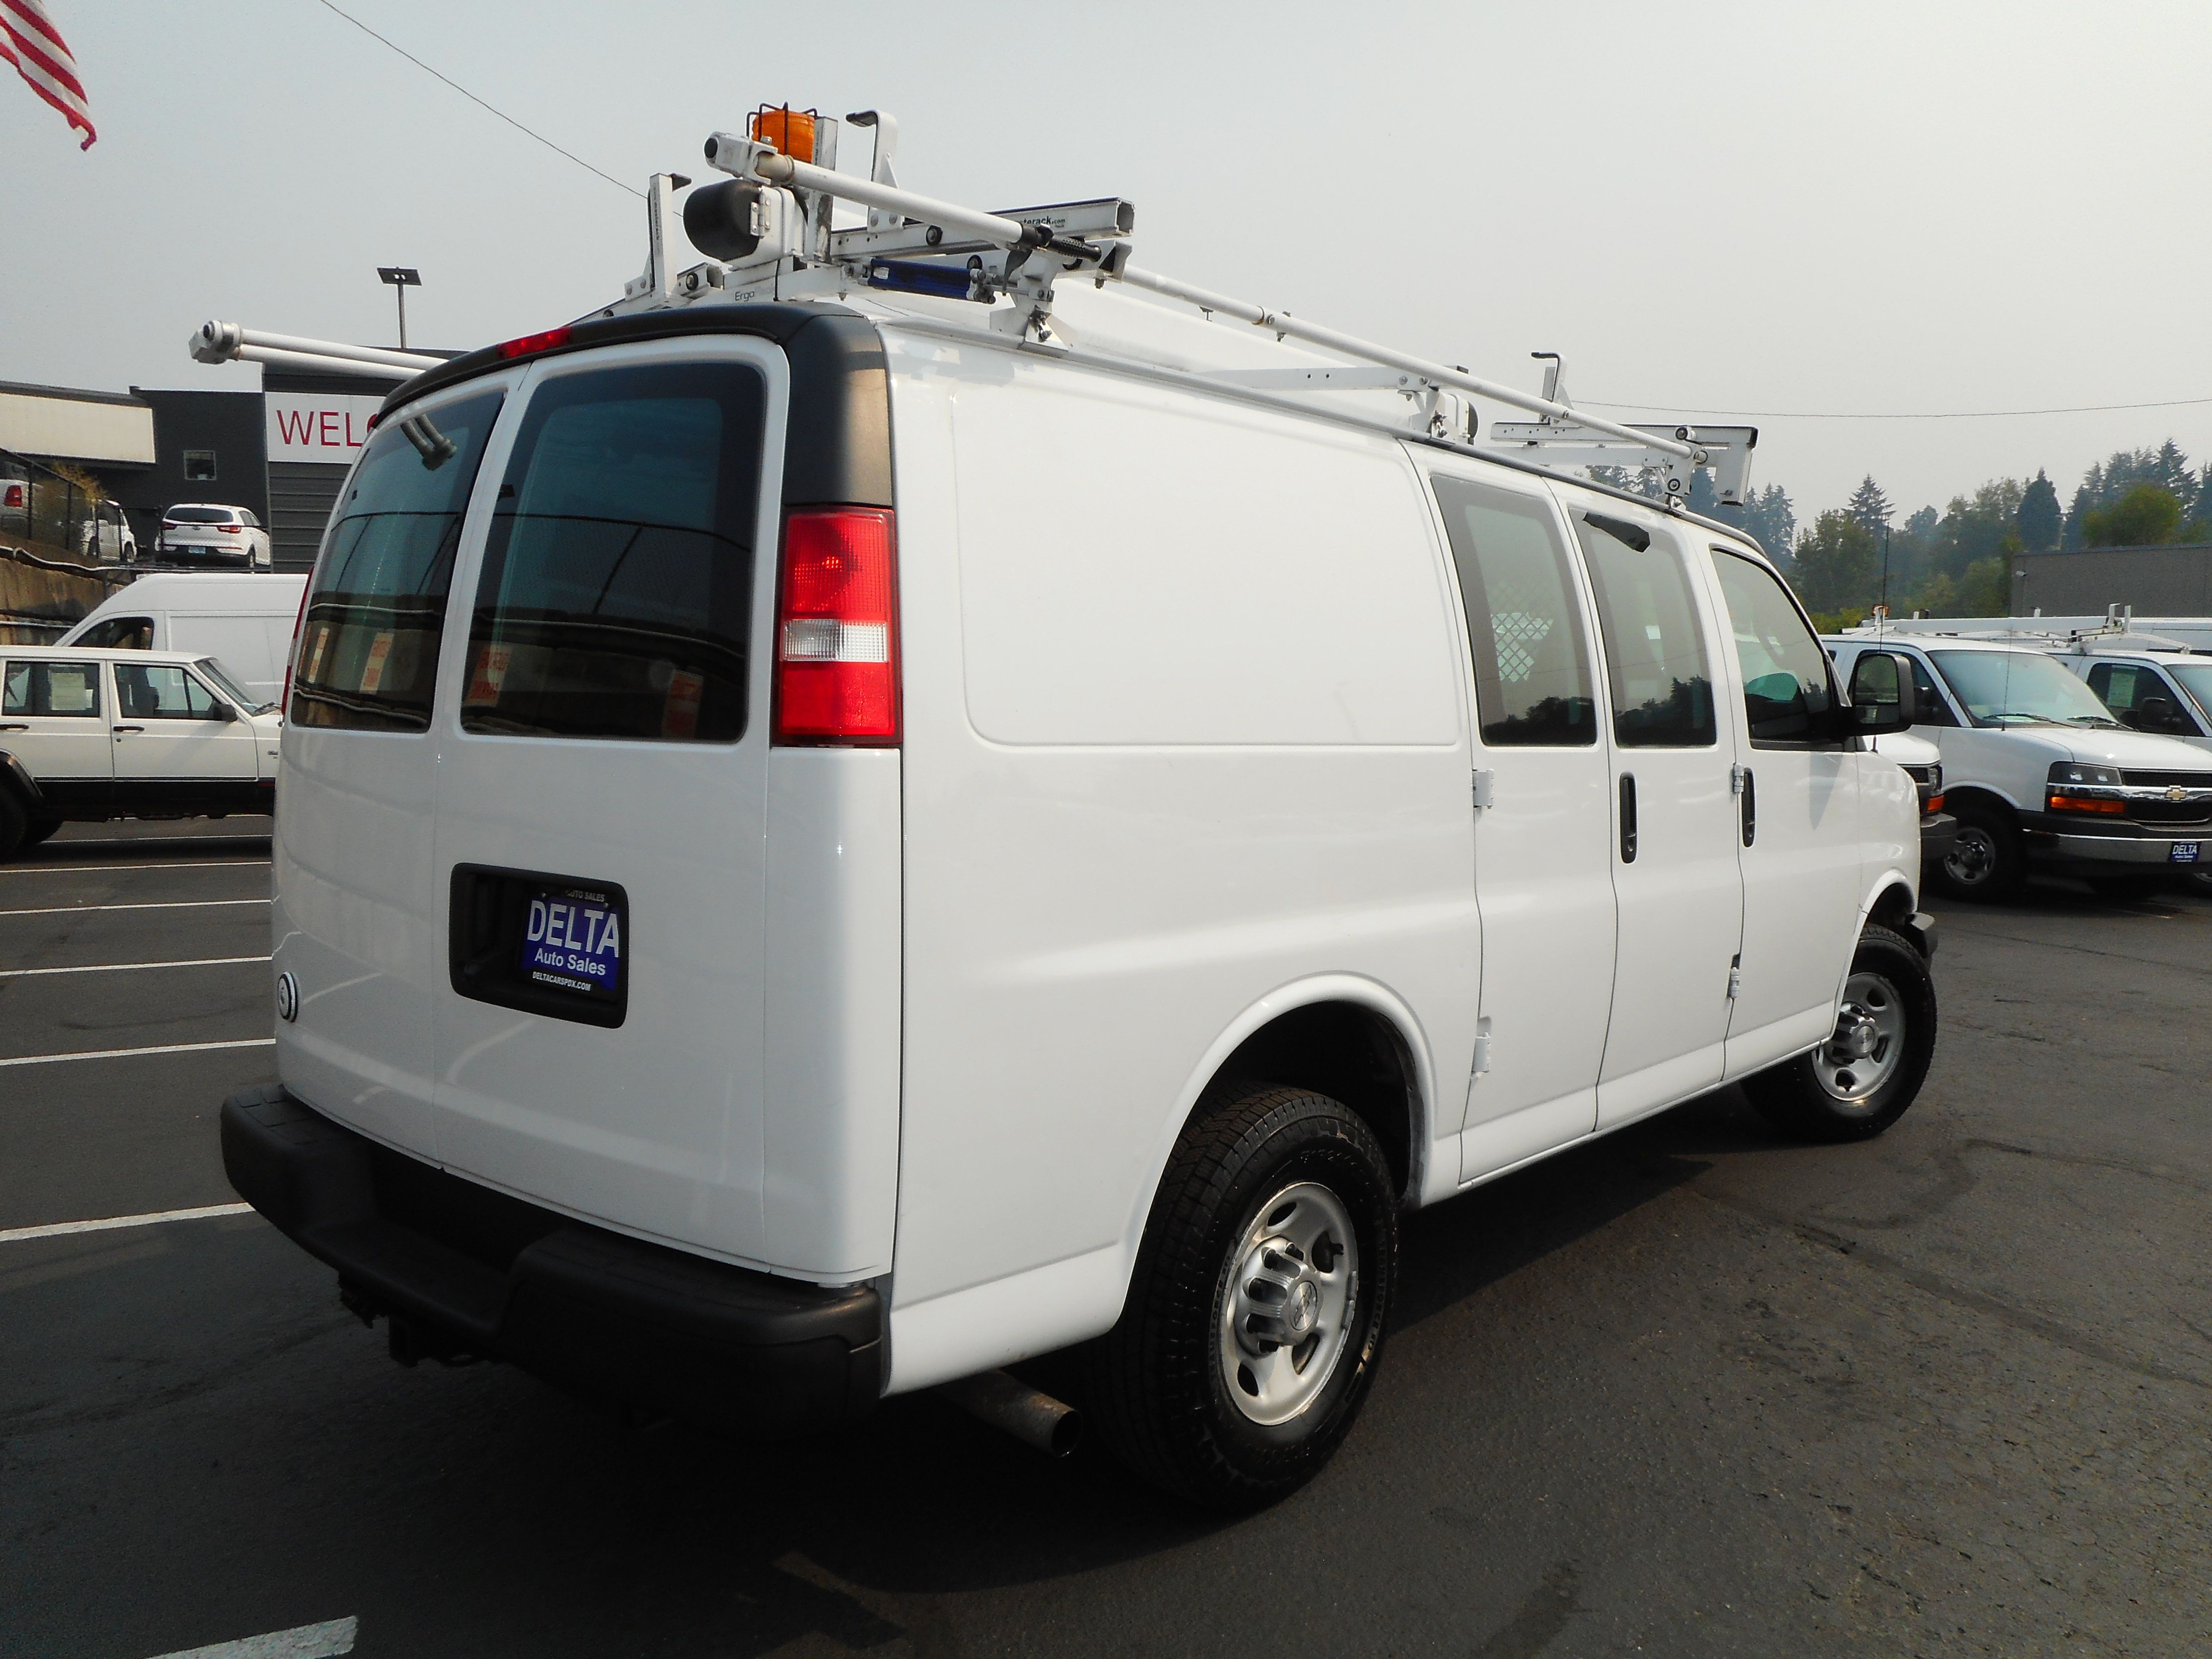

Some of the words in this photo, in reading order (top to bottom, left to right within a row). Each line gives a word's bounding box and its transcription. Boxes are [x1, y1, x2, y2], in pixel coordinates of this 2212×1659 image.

[735, 291, 755, 302] Ergo
[2172, 845, 2197, 854] DELTA
[584, 891, 605, 902] SALES
[527, 900, 620, 958] DELTA
[535, 948, 564, 966] Auto
[567, 954, 606, 975] Sales
[532, 971, 592, 991] DELTACARSPDX.COM
